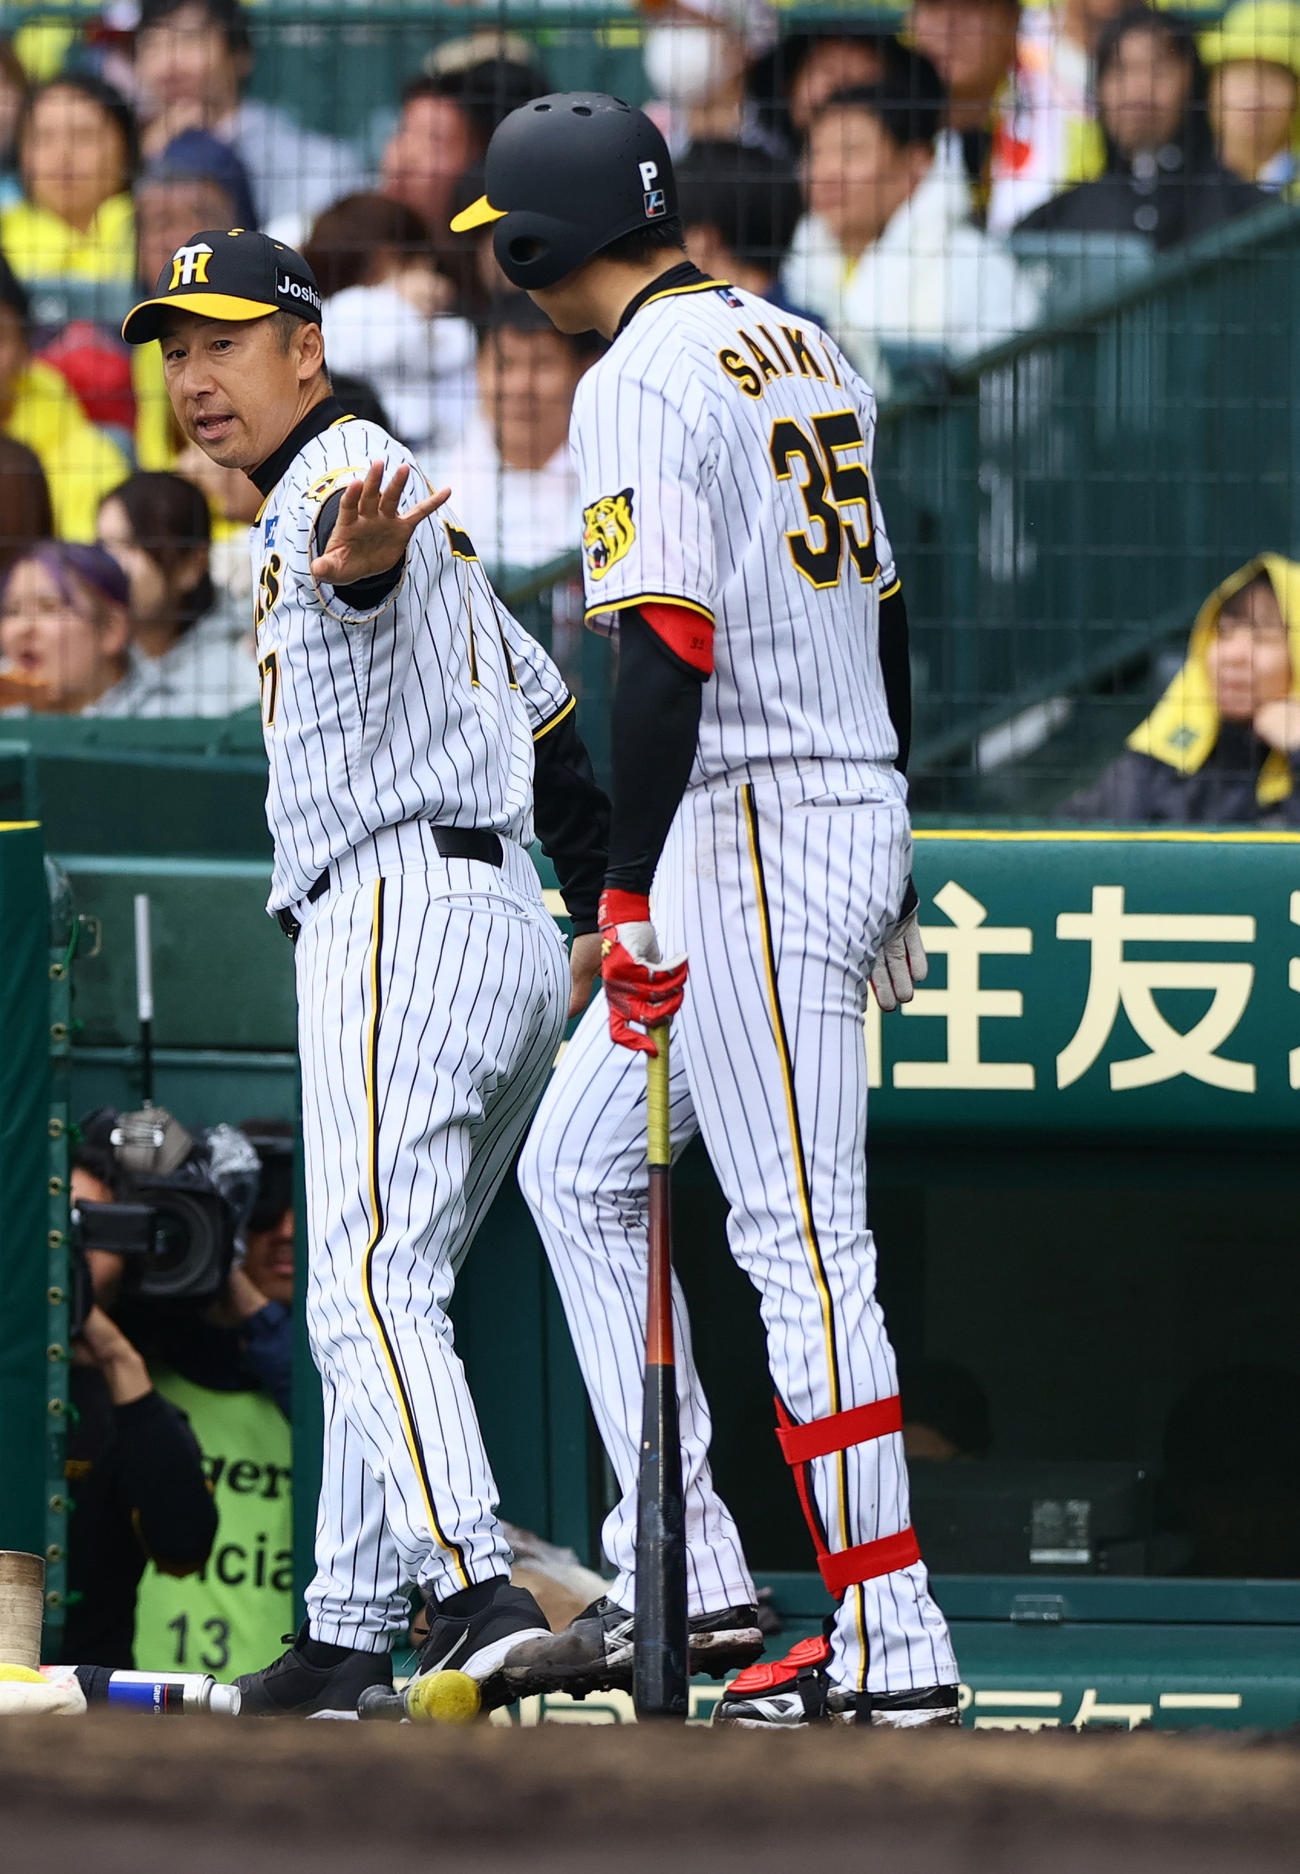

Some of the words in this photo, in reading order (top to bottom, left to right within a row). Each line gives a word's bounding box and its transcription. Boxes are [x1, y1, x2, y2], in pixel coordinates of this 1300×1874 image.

[638, 160, 658, 191] P
[769, 408, 880, 589] 35
[168, 1612, 231, 1671] 13
